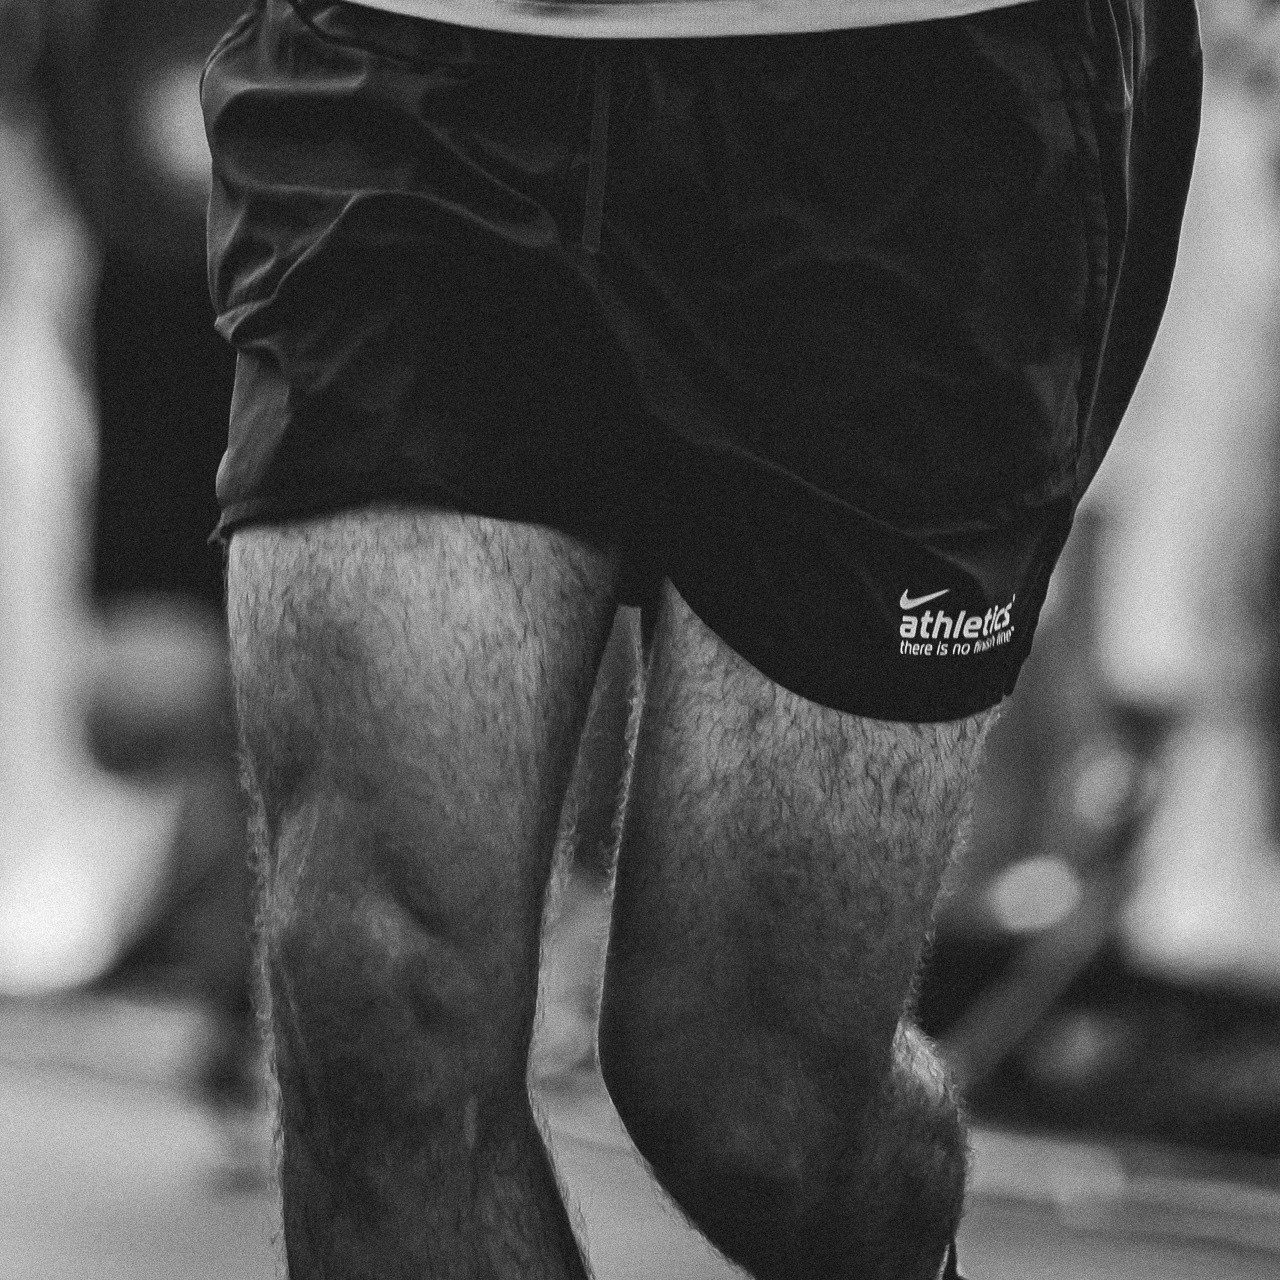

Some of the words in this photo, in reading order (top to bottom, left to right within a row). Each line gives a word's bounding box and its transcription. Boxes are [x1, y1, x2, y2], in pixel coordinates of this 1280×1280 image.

[899, 602, 1013, 639] athletics
[900, 640, 933, 656] there
[936, 641, 949, 656] is
[952, 643, 971, 655] no
